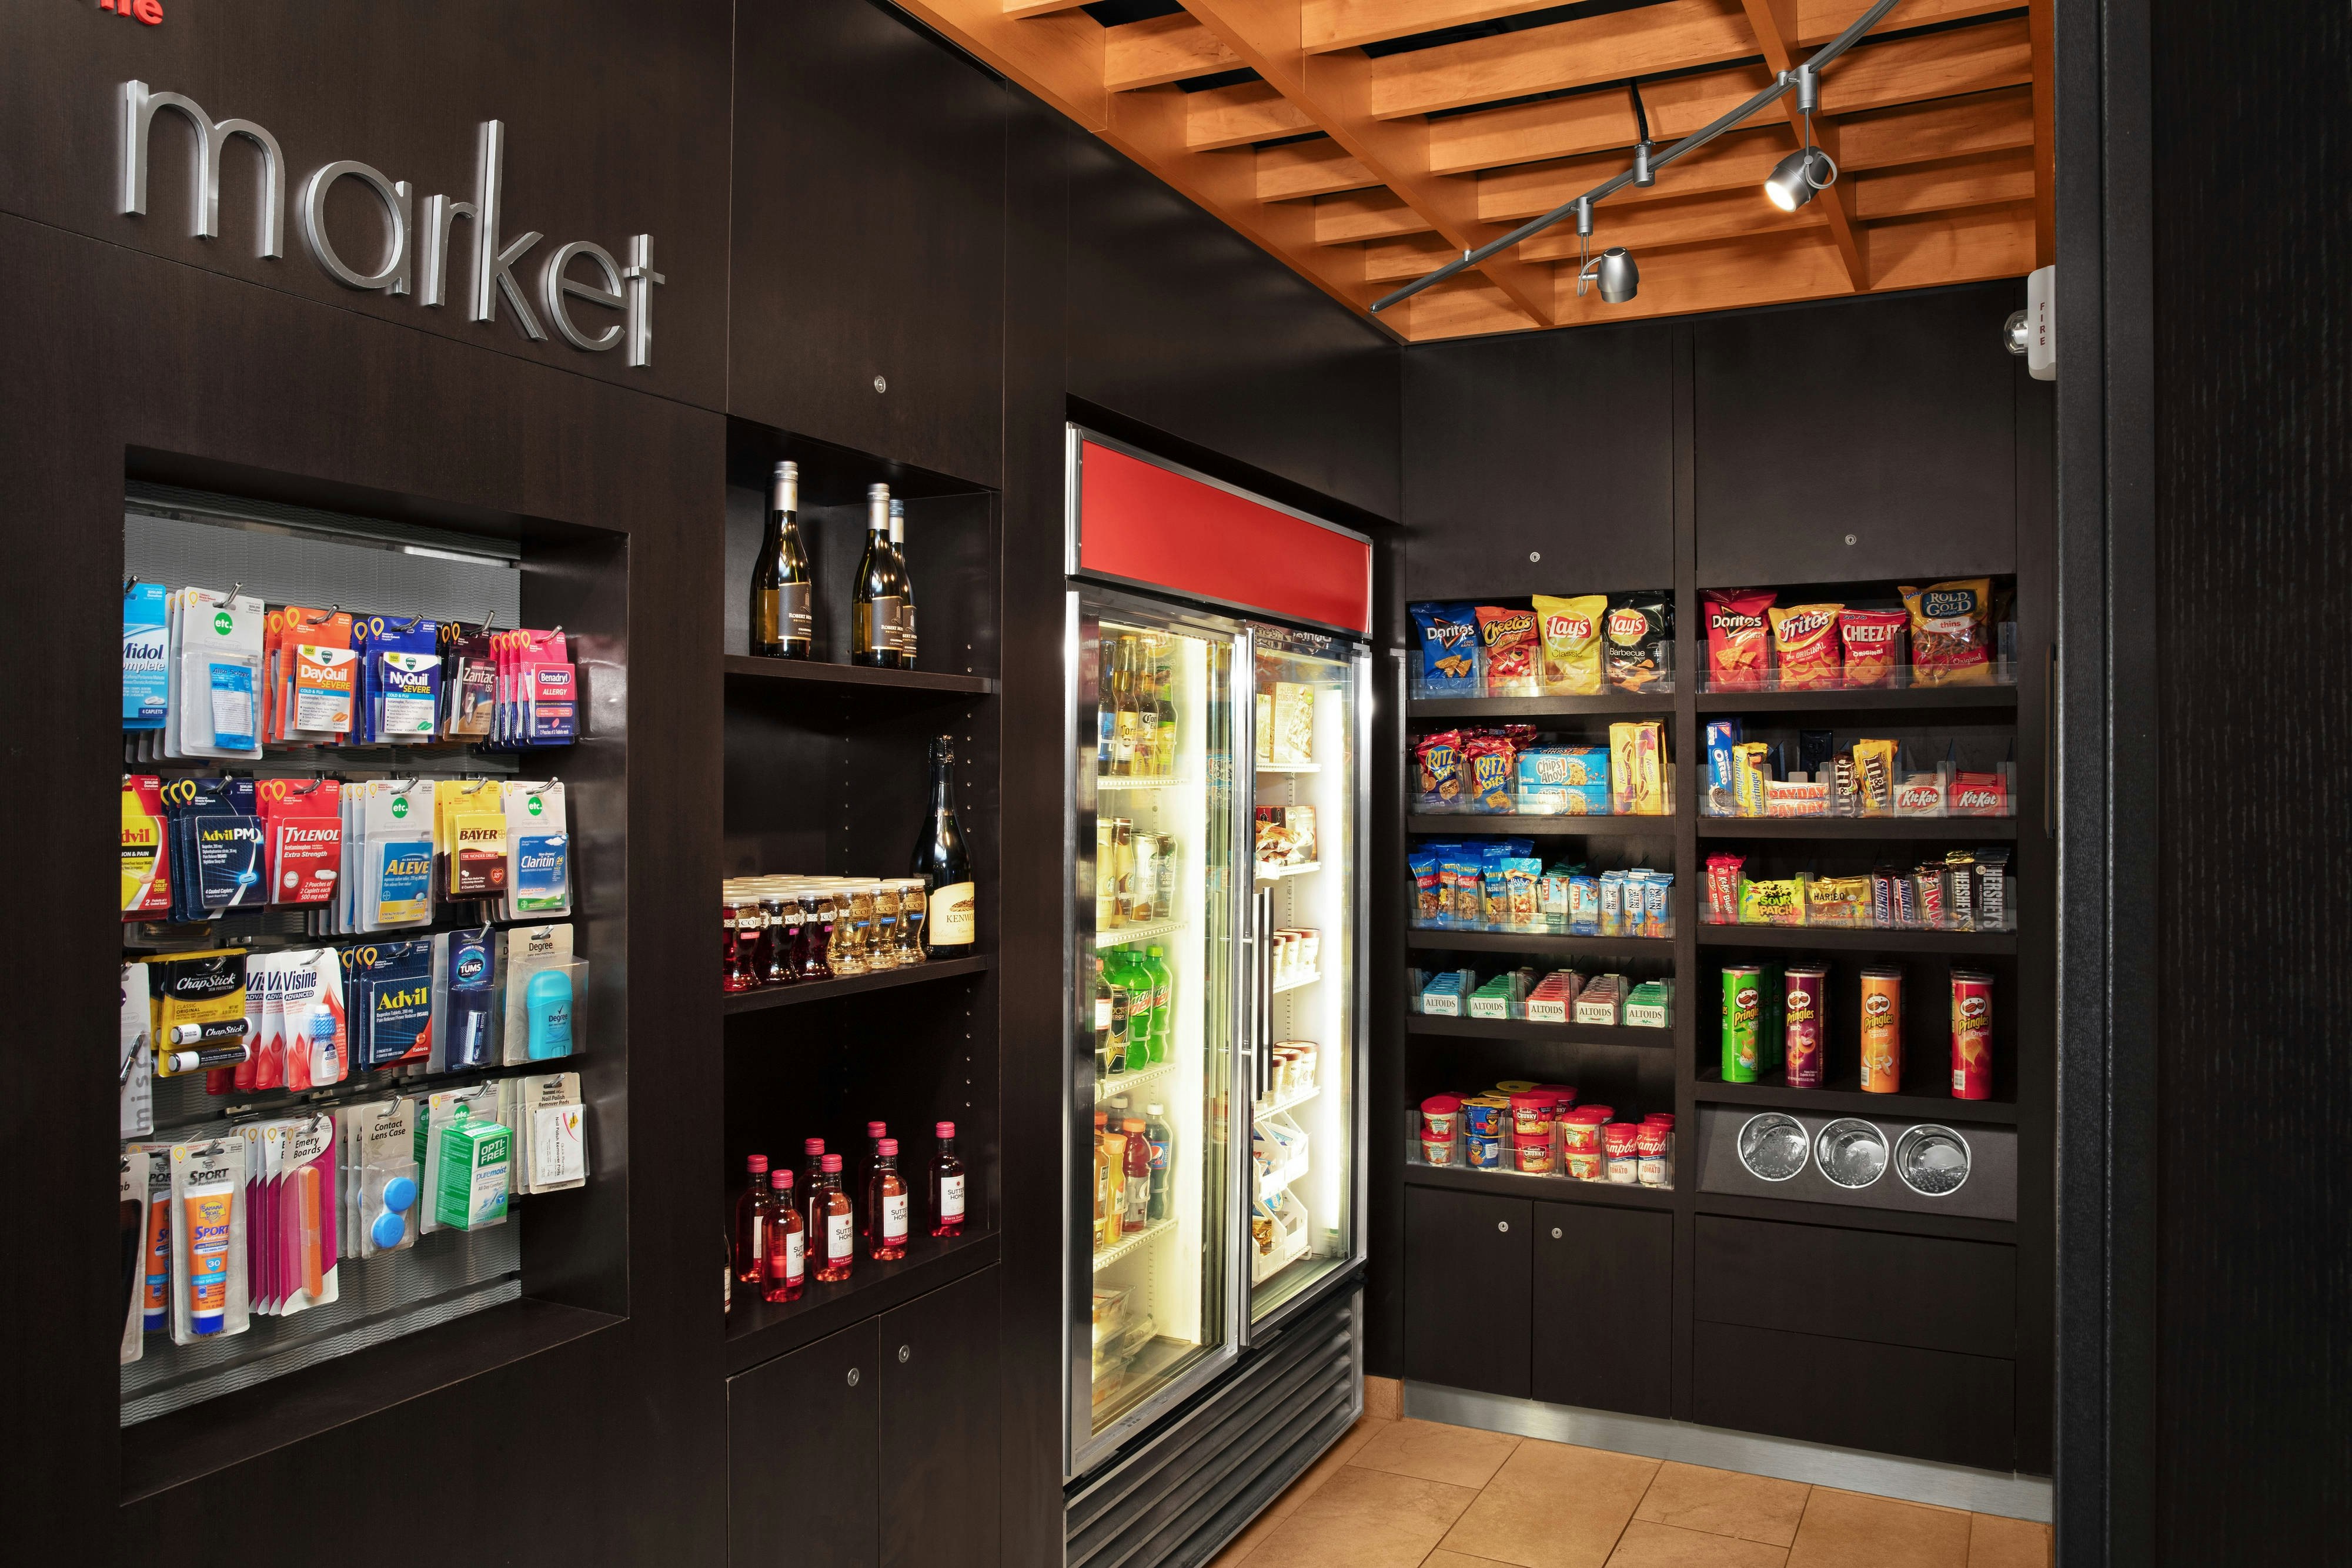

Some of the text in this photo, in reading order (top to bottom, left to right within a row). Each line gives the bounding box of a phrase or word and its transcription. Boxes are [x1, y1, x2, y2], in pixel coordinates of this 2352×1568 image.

[124, 79, 666, 367] market
[1926, 601, 1972, 616] GOLD
[215, 620, 233, 628] etc.
[1549, 617, 1590, 638] Lay's
[1611, 617, 1644, 634] Lay's
[1713, 616, 1762, 628] Doritos
[1779, 611, 1829, 641] Fritos
[1427, 624, 1474, 639] Doritos
[1483, 615, 1533, 644] Cheetos
[1552, 649, 1583, 658] Classic
[1796, 642, 1826, 658] ORIGINAL
[1953, 654, 1982, 665] Original
[123, 661, 165, 674] omplete
[301, 665, 348, 682] DayQuil
[390, 672, 427, 688] NyQuil
[464, 668, 494, 683] Zantac
[540, 673, 567, 683] Benadryl
[321, 680, 350, 690] SEVERE
[403, 685, 430, 694] SEVERE
[1428, 750, 1455, 768] RITZ
[1568, 758, 1586, 768] ORIGINAL
[1713, 748, 1728, 784] OREO
[1475, 757, 1505, 778] RITZ
[1536, 758, 1561, 775] Chips
[1482, 776, 1504, 790] bits
[1735, 756, 1744, 802] Butterfinger
[1752, 771, 1763, 817] Butterfinger
[1769, 786, 1826, 799] PAYDAY
[393, 803, 408, 811] etc.
[1768, 801, 1825, 816] PAYDAY
[122, 828, 150, 843] dvil
[202, 828, 255, 841] Advil PM
[285, 827, 339, 843] TYLENOL
[459, 830, 497, 840] BAYER
[385, 861, 430, 875] ALEVE
[522, 855, 553, 868] Claritin
[1760, 895, 1790, 905] SOUR
[1814, 892, 1845, 901] HARIBO
[1876, 880, 1888, 924] SNICKERS
[1901, 880, 1913, 923] SNICKERS
[1955, 871, 1971, 921] HERSHEY'S
[1983, 868, 2003, 928] HERSHEY'S
[1759, 905, 1792, 915] PATCH
[946, 913, 974, 923] KENWO
[529, 942, 553, 951] Degree
[460, 964, 481, 973] TUMS
[177, 973, 235, 991] ChapStick
[283, 970, 316, 991] Visine
[285, 991, 313, 1000] ADVANCED
[377, 987, 427, 1010] Advil
[1426, 999, 1455, 1008] ALTOIDS
[1474, 1002, 1504, 1011] ALTOIDS
[1532, 1005, 1563, 1014] ALTOIDS
[1579, 1008, 1611, 1017] ALTOIDS
[1629, 1010, 1662, 1019] ALTOIDS
[1788, 1008, 1814, 1027] Pringles
[1864, 1014, 1893, 1033] Pringles
[1959, 1015, 1988, 1035] Pringles
[206, 1025, 243, 1037] ChapStick
[375, 1121, 402, 1131] Contact
[372, 1128, 406, 1141] Lens Case
[295, 1137, 319, 1148] Emery
[482, 1139, 505, 1155] OPTI-
[294, 1145, 320, 1158] Boards
[481, 1149, 505, 1164] FREE
[189, 1169, 229, 1185] SPORT
[476, 1166, 506, 1181] puremoist
[891, 1208, 907, 1216] SUTTE
[195, 1225, 229, 1240] SPORT
[836, 1227, 852, 1235] SUTTE
